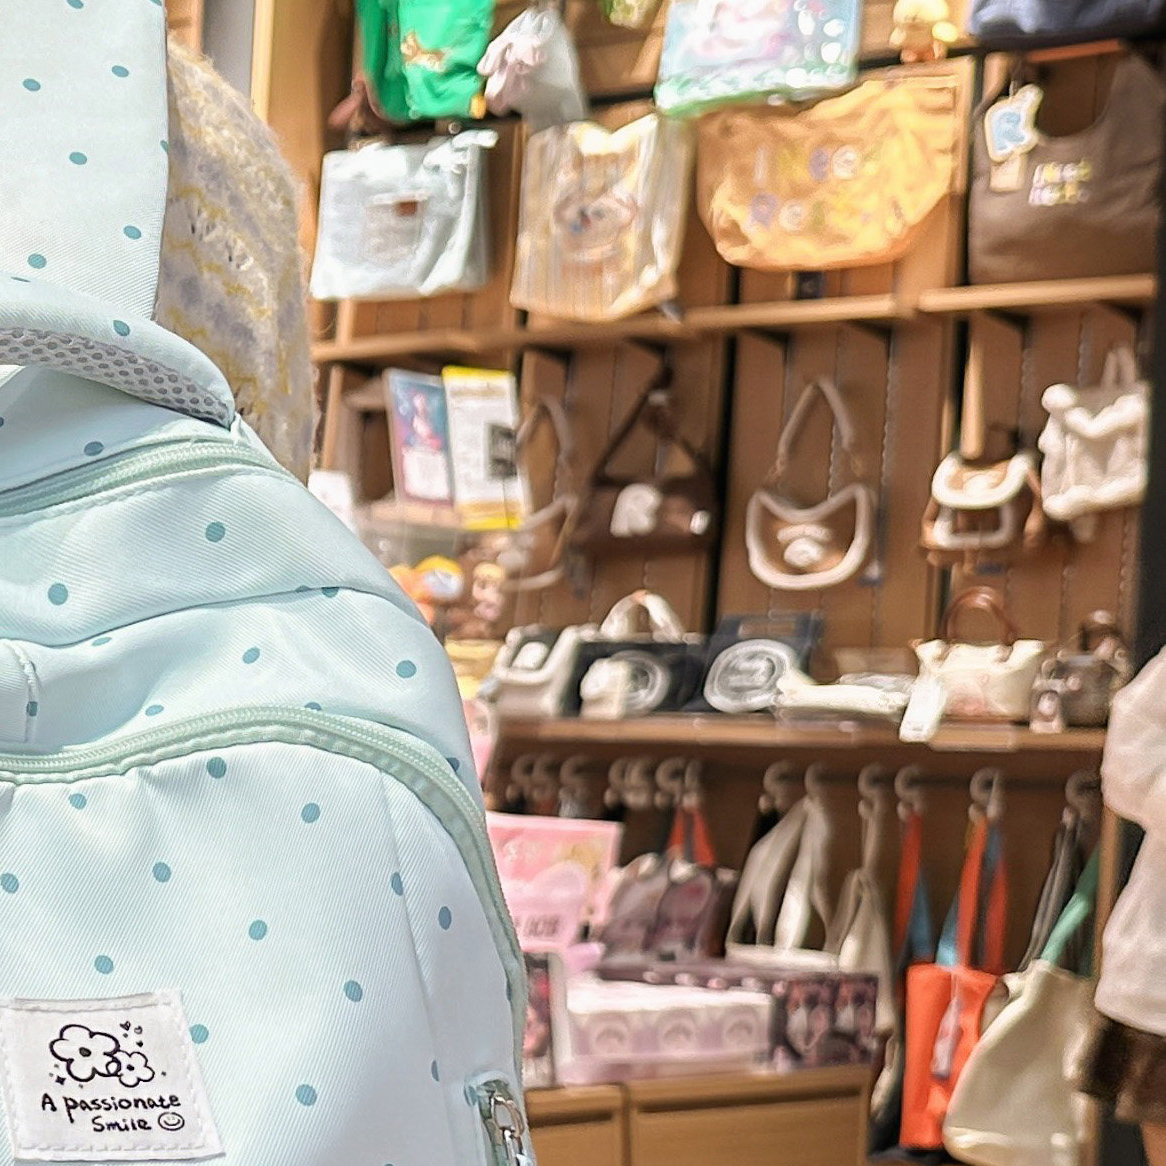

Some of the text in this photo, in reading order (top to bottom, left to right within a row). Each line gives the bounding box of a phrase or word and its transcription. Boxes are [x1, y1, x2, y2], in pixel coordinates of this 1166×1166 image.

[41, 1093, 181, 1124] A passionate
[92, 1114, 152, 1132] Smile
